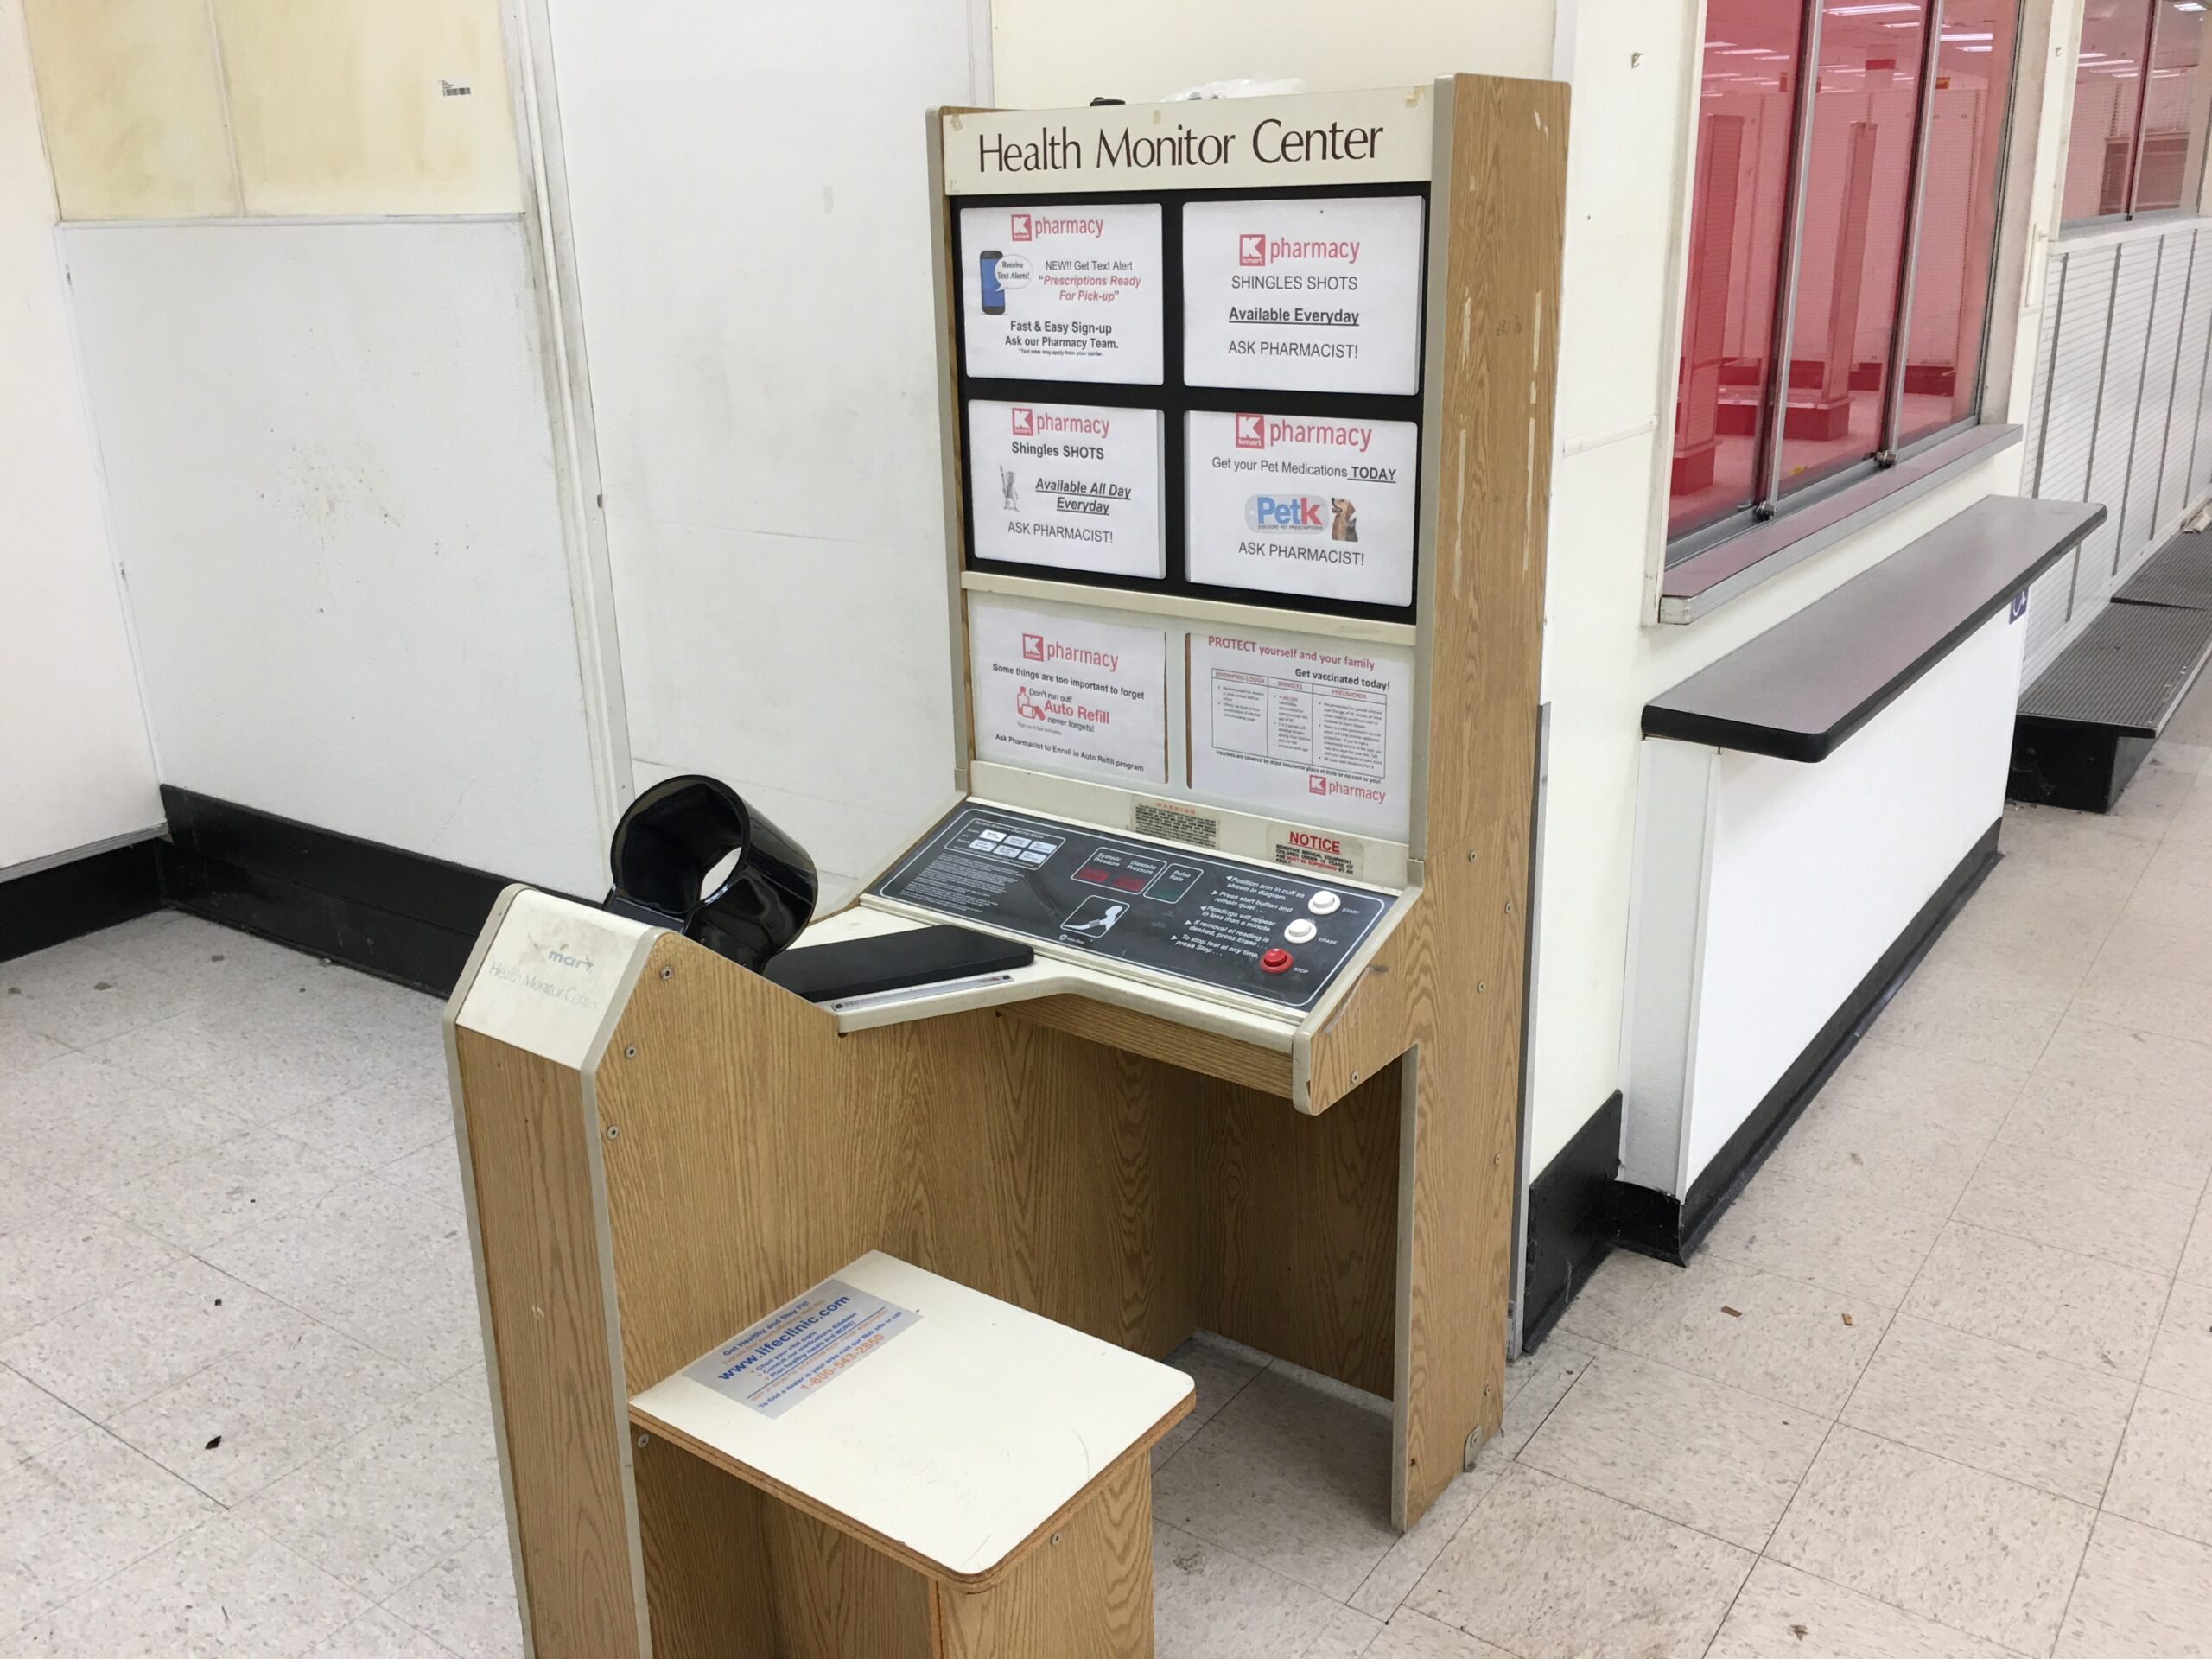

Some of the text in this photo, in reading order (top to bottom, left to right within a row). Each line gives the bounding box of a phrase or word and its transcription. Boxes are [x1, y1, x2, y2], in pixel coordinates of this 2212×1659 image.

[979, 118, 1384, 172] Health Monitor Center
[1035, 216, 1103, 238] pharmacy
[1271, 238, 1359, 264] pharmacy
[1046, 261, 1133, 271] NEW!! Get Text Alert
[1110, 276, 1141, 288] Ready
[1231, 276, 1357, 290] SHINGLES SHOTS
[1059, 290, 1076, 301] For
[1229, 307, 1359, 326] Available Everyday
[1010, 321, 1112, 335] Fast & Easy Sign-up
[1005, 336, 1021, 346] Ask
[1042, 337, 1087, 350] Pharmacy
[1090, 339, 1118, 348] Team.
[1229, 340, 1358, 359] ASK PHARMACIST!
[1037, 413, 1109, 438] pharmacy
[1270, 419, 1372, 452] pharmacy
[1012, 442, 1104, 460] Shingles SHOTS
[1212, 457, 1396, 480] Get your Pet Medications TODAY
[1036, 478, 1131, 499] Available All Day
[1057, 497, 1109, 515] Everyday
[1257, 497, 1322, 525] Petk
[1008, 521, 1113, 543] ASK PHARMACIST!
[1238, 542, 1364, 566] ASK PHARMACIST!
[1047, 642, 1118, 672] pharmacy
[1208, 636, 1375, 671] PROTECT yourself and your family
[993, 664, 1014, 674] Some
[1016, 668, 1039, 680] things
[1056, 676, 1068, 684] too
[1071, 678, 1108, 693] important
[1121, 687, 1144, 700] forget
[1215, 671, 1244, 683] WHOOPING
[1295, 669, 1390, 690] Get vaccinated today!
[1029, 689, 1046, 698] Don't
[1060, 695, 1072, 703] out!
[1332, 690, 1367, 699] PNEUMONIA
[1045, 700, 1109, 724] Auto Refill
[1047, 716, 1094, 732] never forgets!
[995, 734, 1007, 742] Ask
[1008, 736, 1043, 749] Pharmacist
[1052, 746, 1071, 755] Enroll
[1081, 752, 1096, 761] Auto
[1097, 755, 1115, 765] Refill
[1116, 760, 1144, 772] program
[1329, 781, 1385, 804] pharmacy
[1290, 831, 1340, 854] NOTICE
[1093, 857, 1120, 867] Pressure
[1097, 852, 1122, 862] Systolic
[1130, 860, 1157, 870] Diastolic
[1126, 865, 1154, 874] Pressure
[1227, 883, 1249, 892] shown
[1231, 877, 1259, 887] Position
[1214, 898, 1237, 908] remain
[1219, 891, 1239, 899] Press
[1255, 900, 1278, 909] button
[1207, 906, 1238, 917] Readings
[1251, 917, 1276, 925] appear
[1199, 922, 1228, 931] removal
[1236, 931, 1262, 942] reading
[1318, 937, 1338, 945] ERASE
[1175, 940, 1196, 949] press
[1236, 938, 1257, 946] Erase
[489, 962, 600, 1010] Health Monitor Center
[719, 1295, 851, 1381] www.lifeclinic.com
[723, 1346, 739, 1356] Get
[737, 1328, 766, 1346] Healthy
[766, 1319, 780, 1329] and
[780, 1310, 798, 1319] Stay
[801, 1334, 885, 1390] 1-800-543-2850
